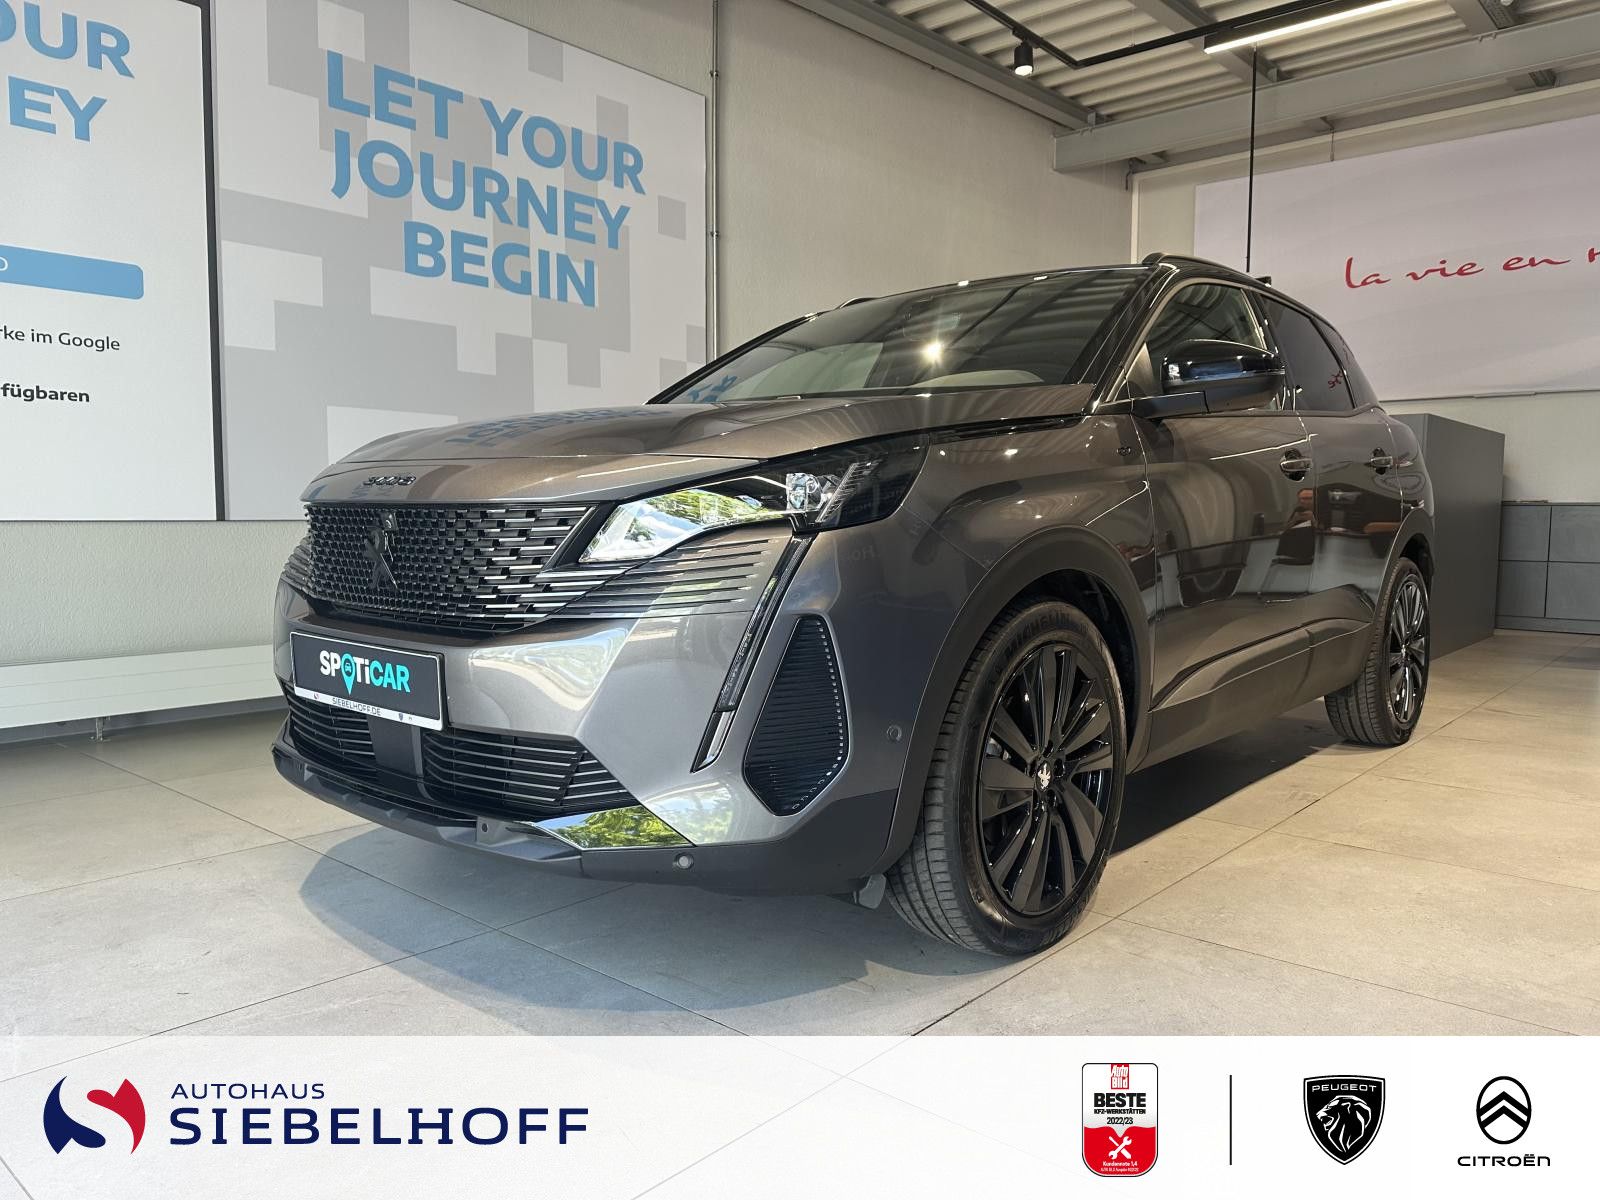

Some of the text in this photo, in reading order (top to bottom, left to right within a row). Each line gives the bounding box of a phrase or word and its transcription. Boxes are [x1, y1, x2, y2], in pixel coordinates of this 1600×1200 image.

[327, 50, 646, 196] LET YOUR
[331, 129, 630, 250] JOURNEY
[403, 221, 596, 308] BEGIN
[1406, 259, 1484, 281] vie
[1502, 256, 1571, 271] en
[0, 325, 120, 352] ke im Google
[0, 383, 90, 402] fügbaren
[332, 697, 382, 716] SIEBELHOFF.DE
